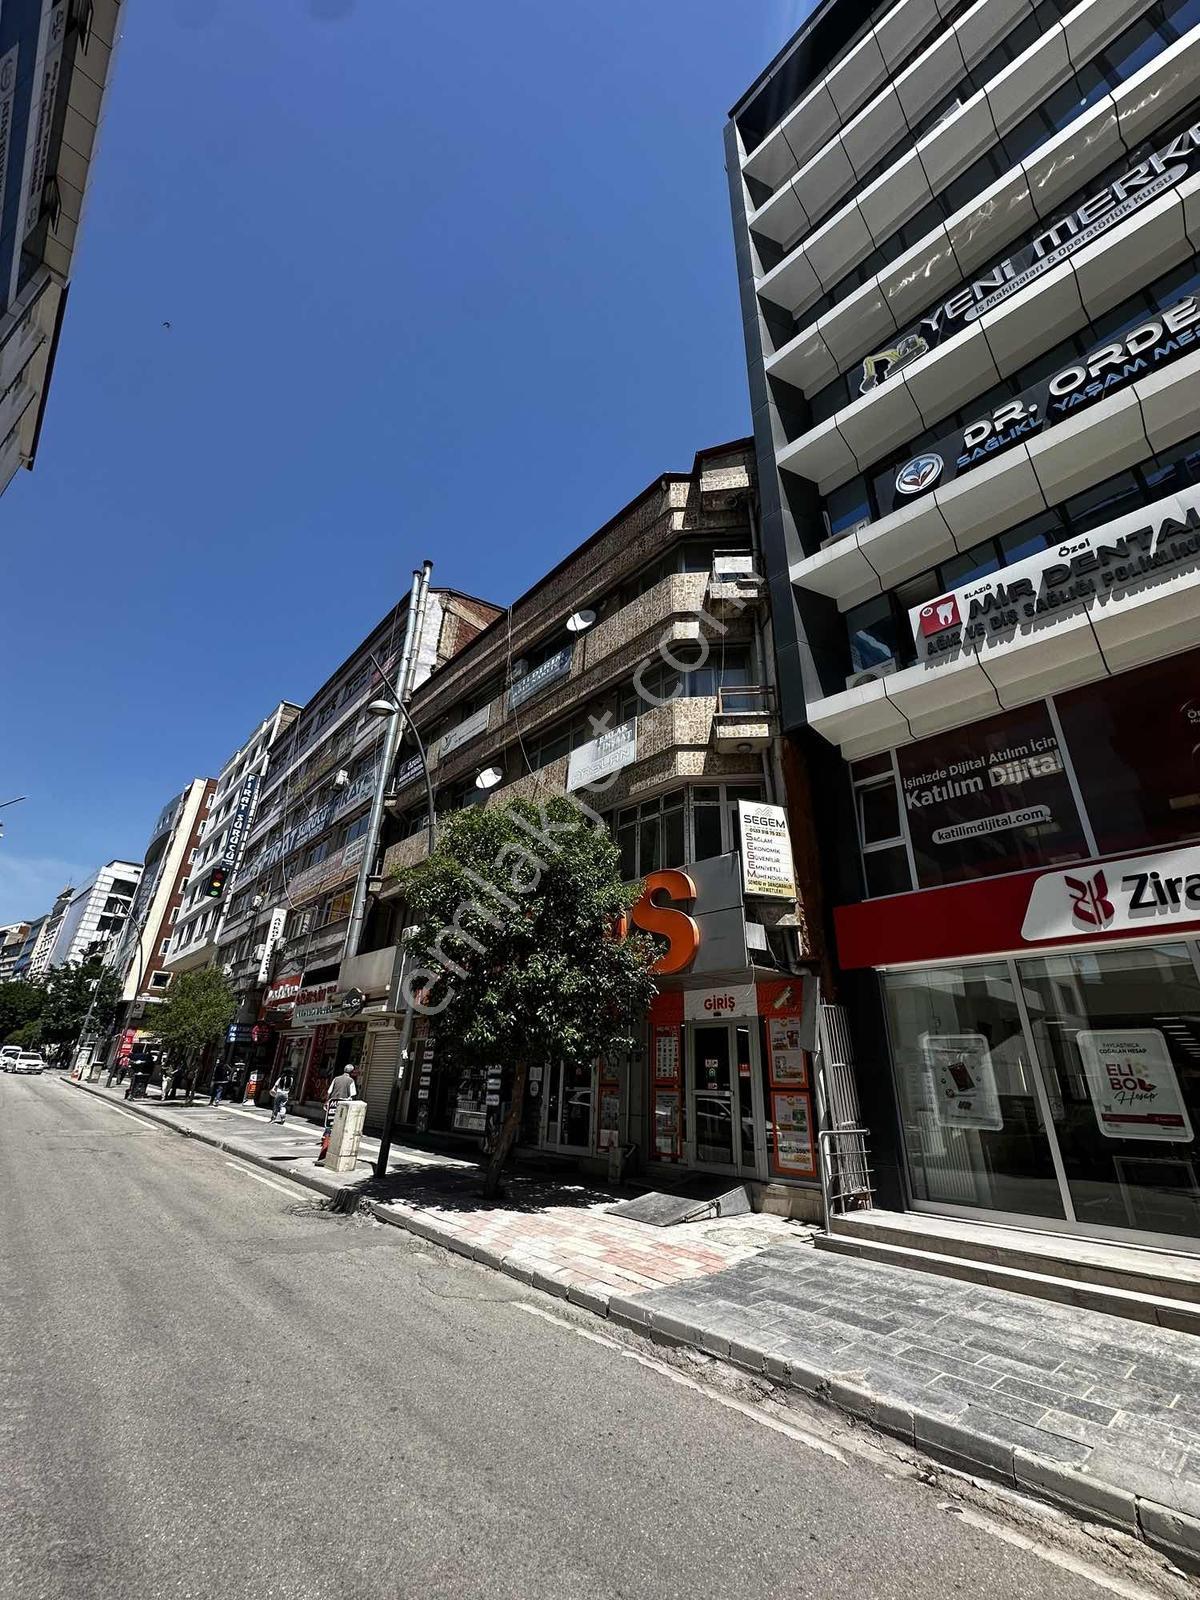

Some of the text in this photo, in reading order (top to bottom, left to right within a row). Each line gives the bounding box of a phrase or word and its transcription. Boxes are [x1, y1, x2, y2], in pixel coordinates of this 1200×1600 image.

[986, 264, 1044, 307] Makinaları
[1047, 253, 1057, 264] &
[1057, 202, 1132, 257] Operatörlük
[1133, 174, 1174, 205] Kursu
[1052, 358, 1148, 412] YAŞAM
[963, 400, 1038, 448] DR.
[1058, 537, 1091, 558] Özel
[964, 620, 986, 640] VE
[902, 735, 1057, 790] İşinizde Dijital Atılım İçin
[905, 749, 1063, 810] Katılım Dijital
[743, 814, 786, 829] SEGEM
[937, 807, 1044, 842] katilimdijital.com
[703, 991, 736, 1013] GİRİŞ
